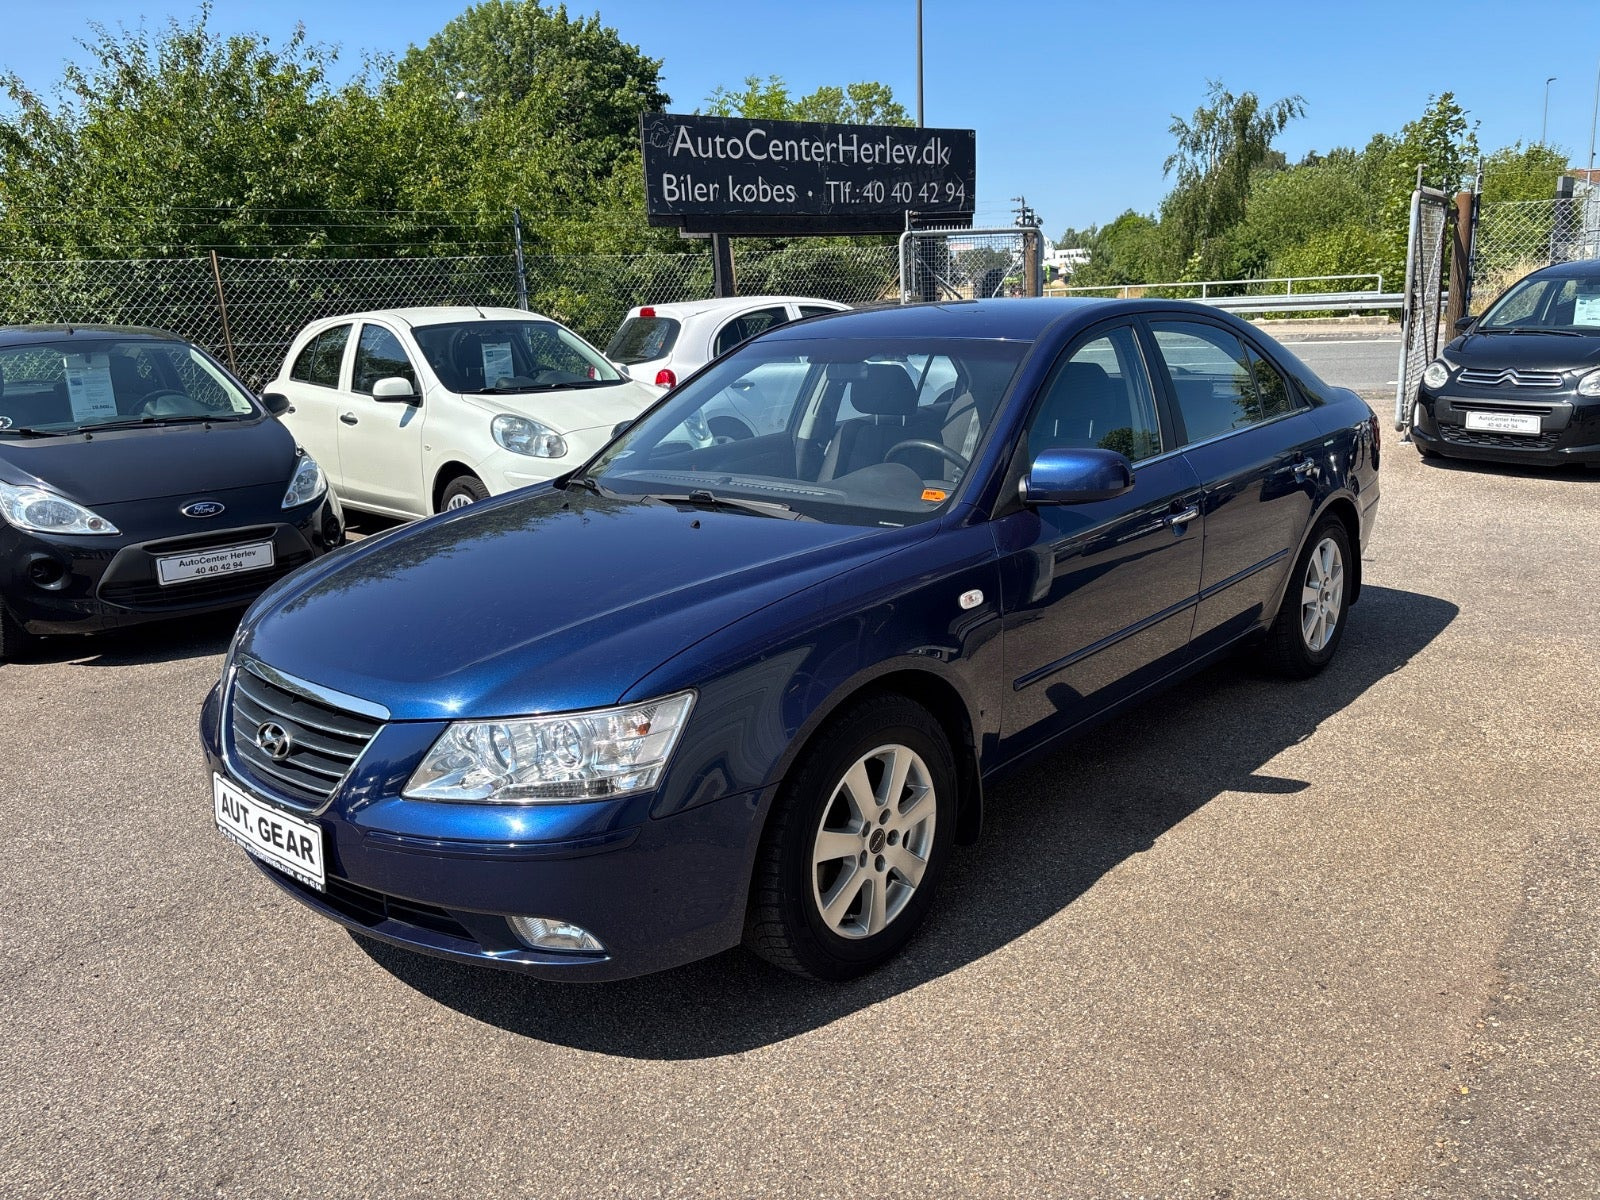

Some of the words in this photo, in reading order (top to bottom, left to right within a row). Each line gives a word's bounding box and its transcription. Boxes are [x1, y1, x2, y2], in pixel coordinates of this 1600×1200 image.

[673, 124, 950, 165] AutoCenterHerlev.dk
[662, 173, 720, 203] Biler
[728, 175, 796, 203] købes
[891, 181, 913, 204] 40
[918, 181, 939, 203] 42
[945, 181, 966, 204] 94
[193, 504, 216, 515] Ford
[178, 555, 228, 568] AutoCenter
[230, 549, 257, 559] Herlev
[195, 567, 206, 575] 40
[208, 565, 218, 573] 40
[220, 563, 231, 571] 42
[233, 561, 243, 569] 94
[221, 791, 254, 834] AUT.
[258, 816, 316, 865] GEAR
